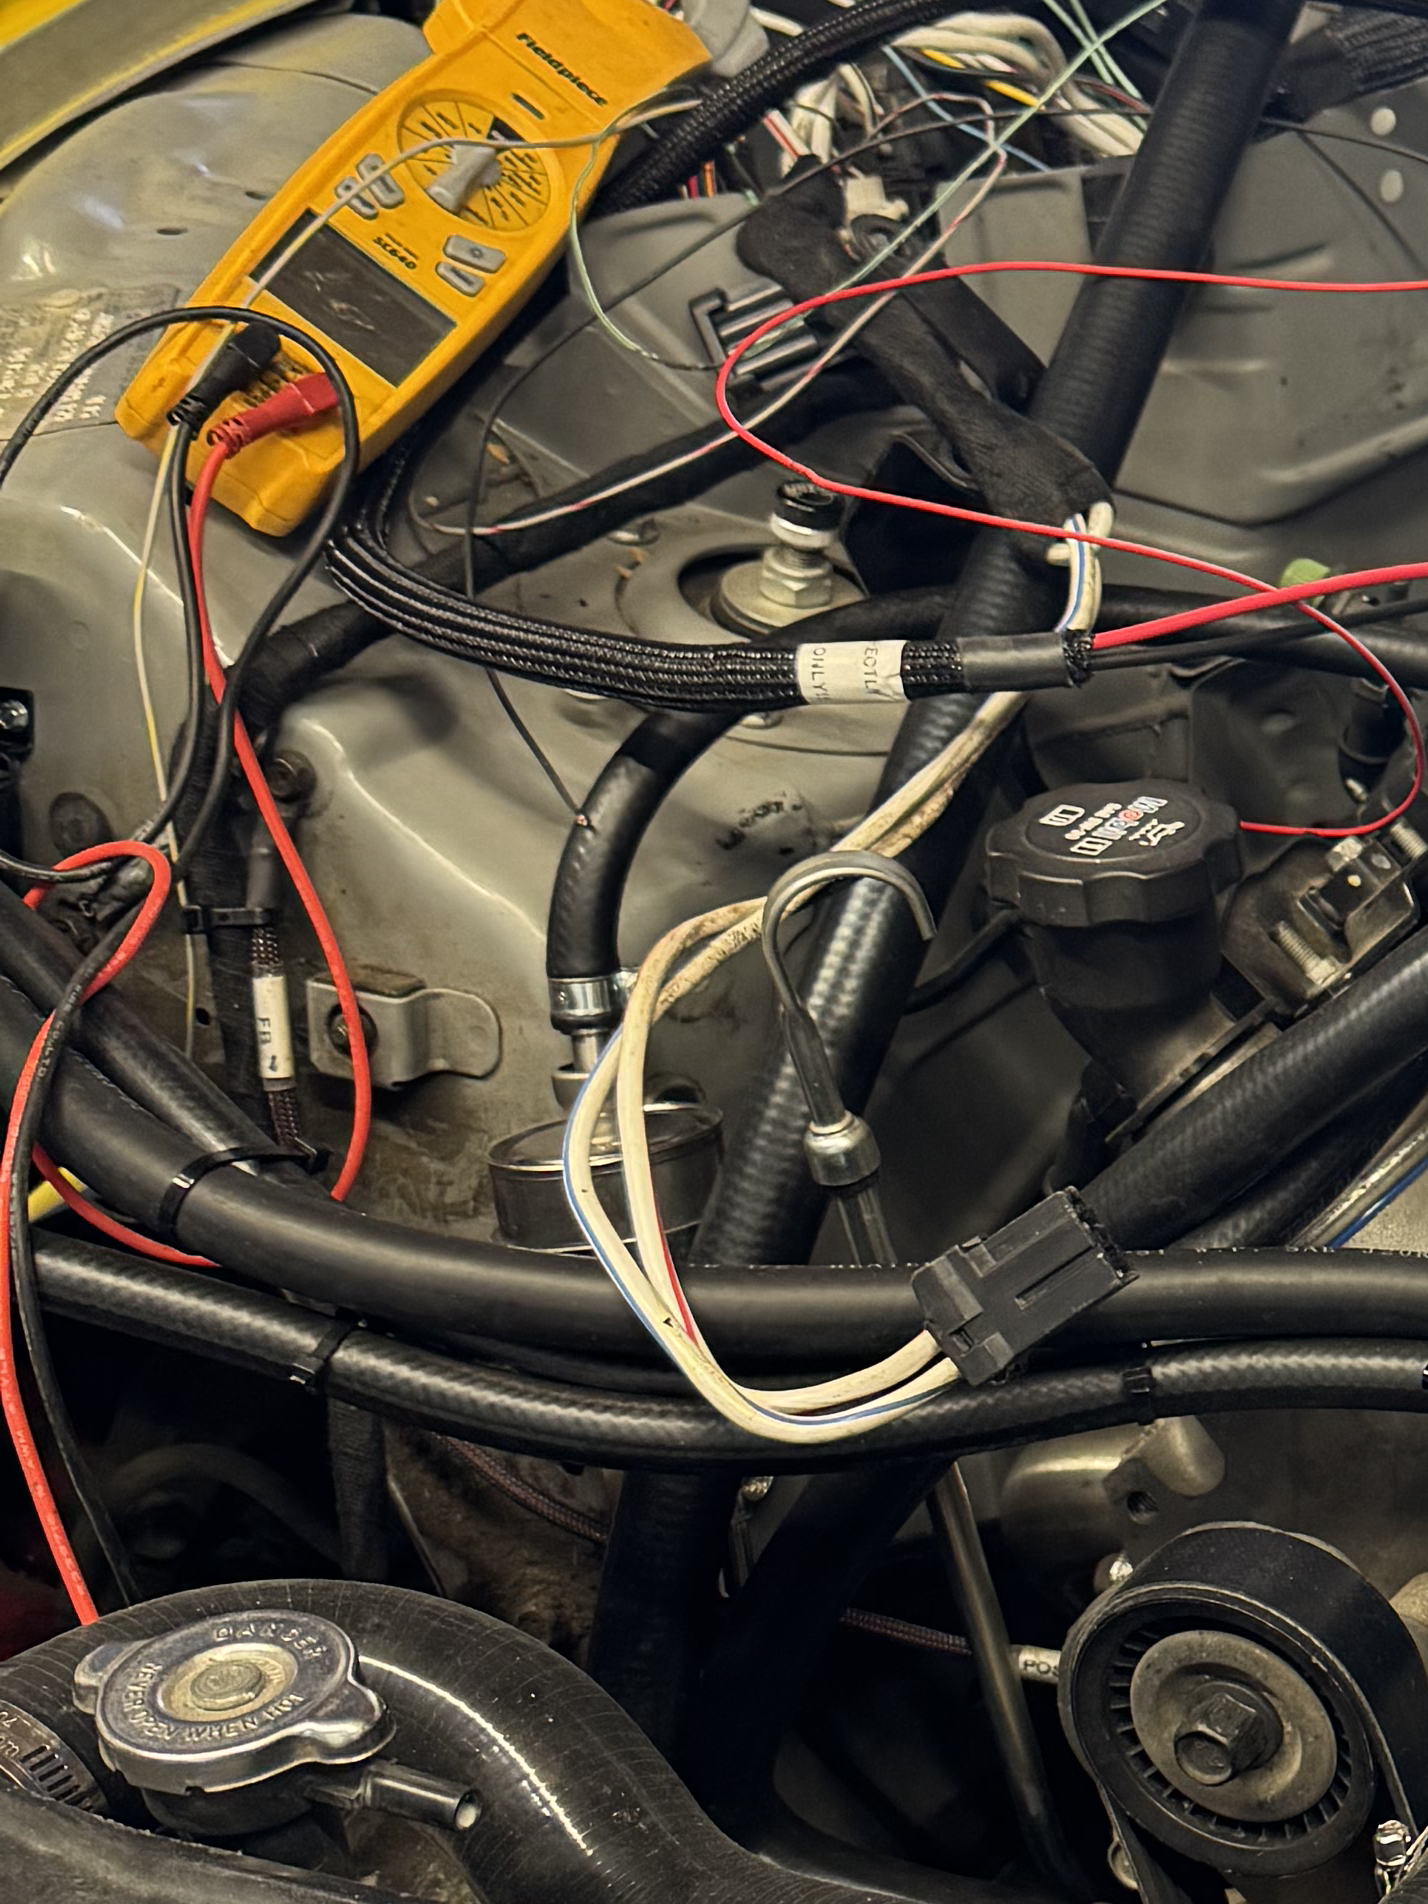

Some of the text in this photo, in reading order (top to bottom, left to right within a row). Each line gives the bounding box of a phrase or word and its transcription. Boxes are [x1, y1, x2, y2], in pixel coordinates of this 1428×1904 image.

[516, 33, 609, 107] Fieldpiece
[213, 1622, 329, 1661] DANGER
[122, 1662, 306, 1743] NEVER OPEN WHEN HOT
